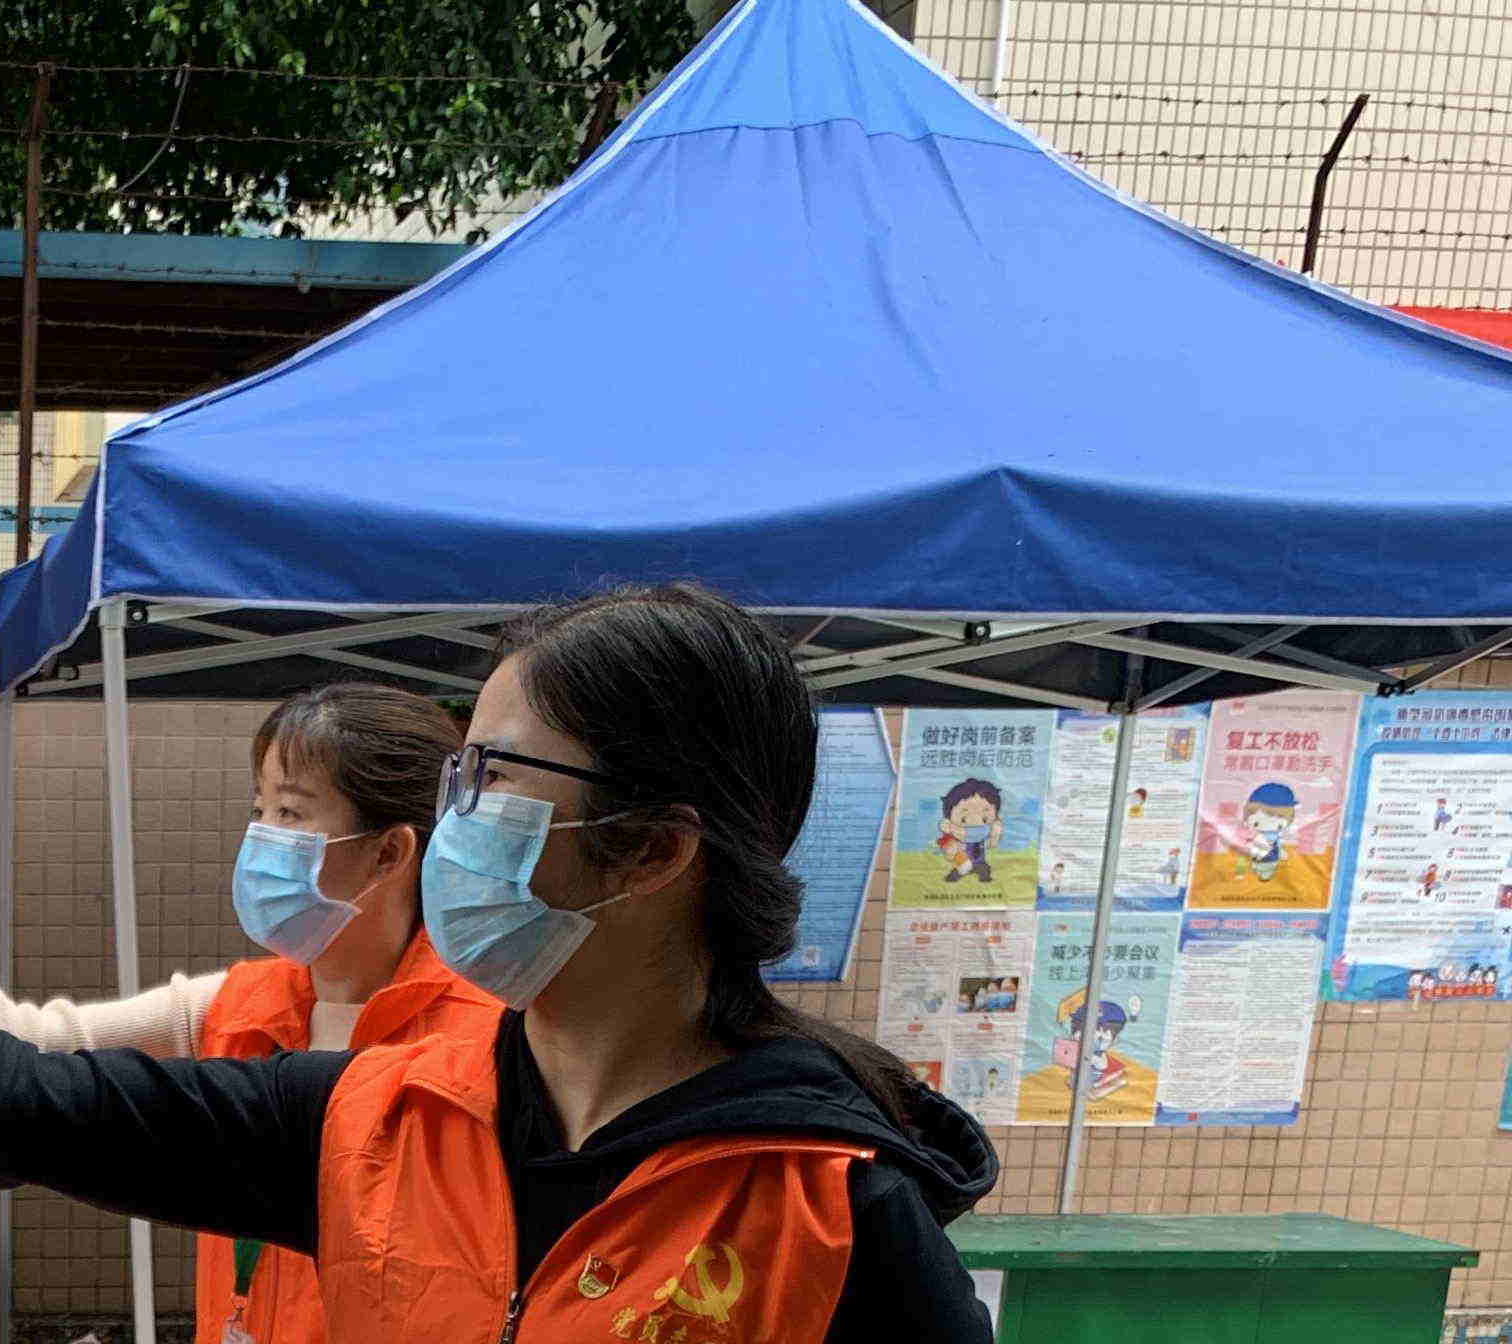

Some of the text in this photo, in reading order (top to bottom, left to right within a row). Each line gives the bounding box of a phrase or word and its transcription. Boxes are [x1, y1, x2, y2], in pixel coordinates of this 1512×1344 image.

[1226, 729, 1320, 750] 复工不放松
